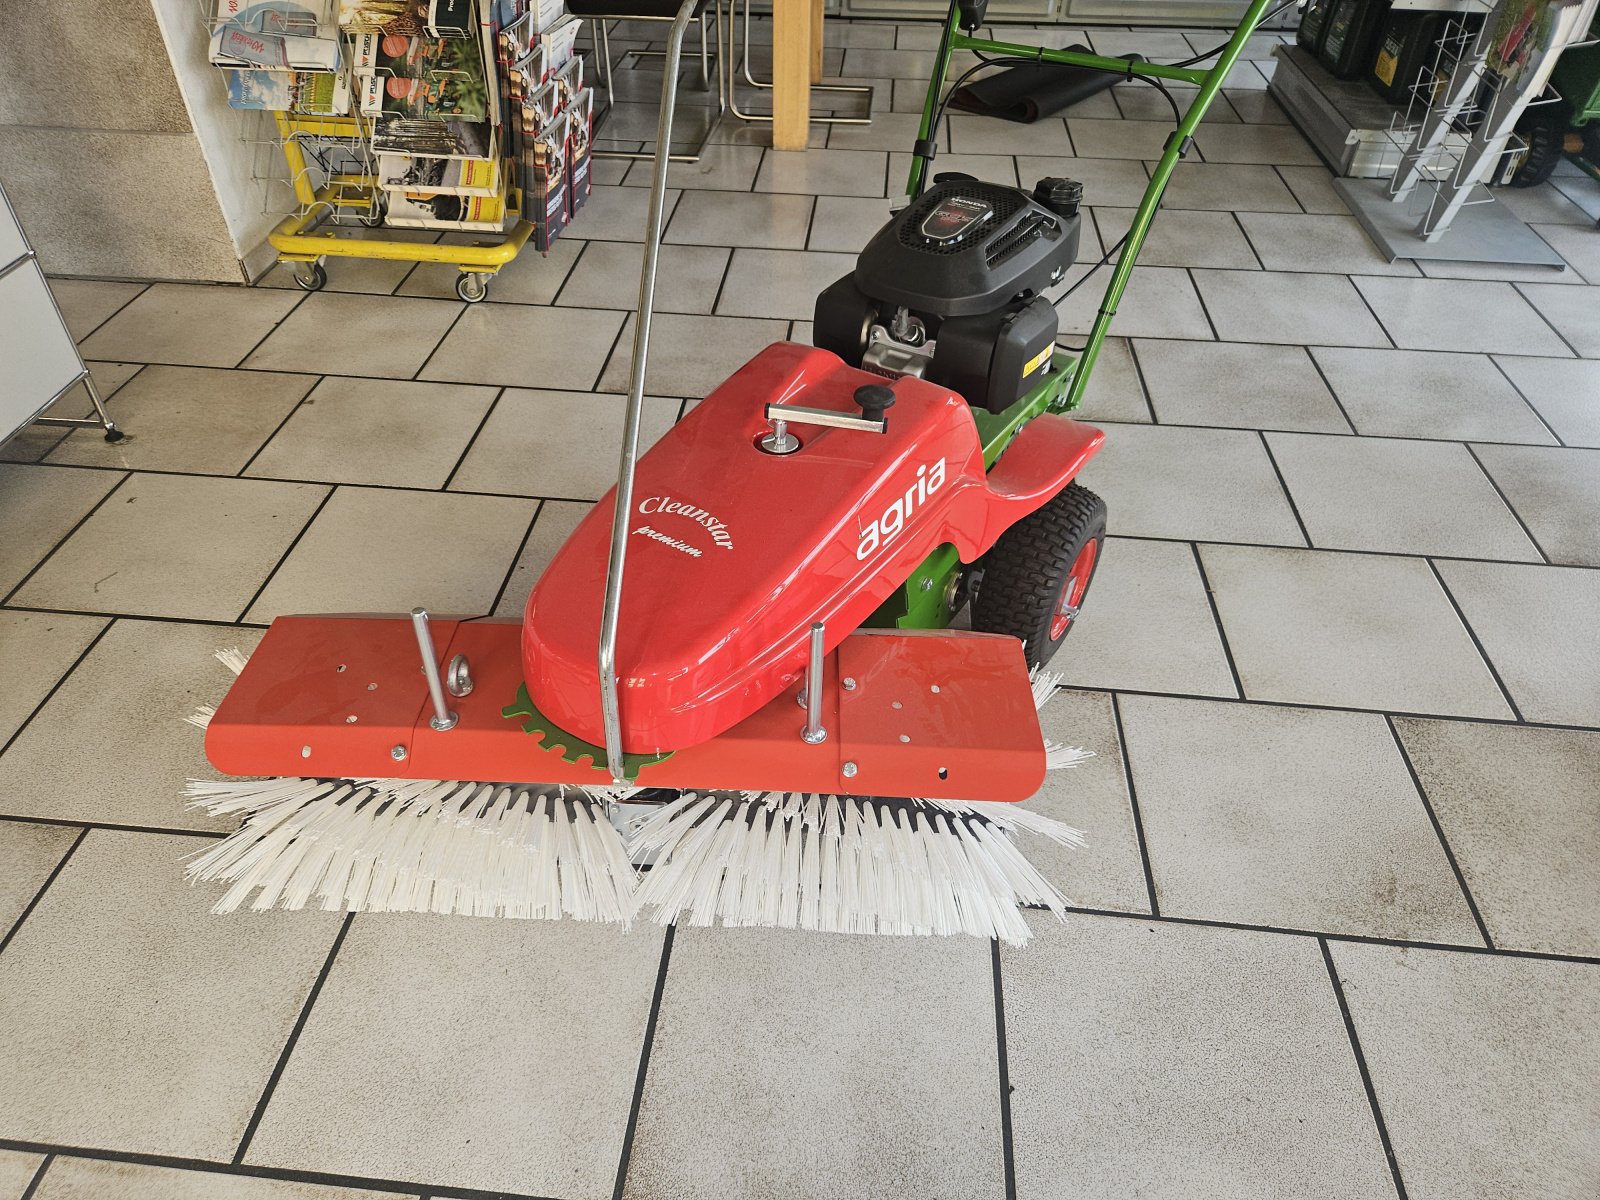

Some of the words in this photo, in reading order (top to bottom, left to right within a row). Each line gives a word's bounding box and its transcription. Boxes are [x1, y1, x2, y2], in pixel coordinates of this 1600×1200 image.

[951, 197, 987, 209] HONDA
[639, 496, 734, 550] Cleanstar
[856, 456, 945, 561] agria
[631, 525, 703, 558] premium
